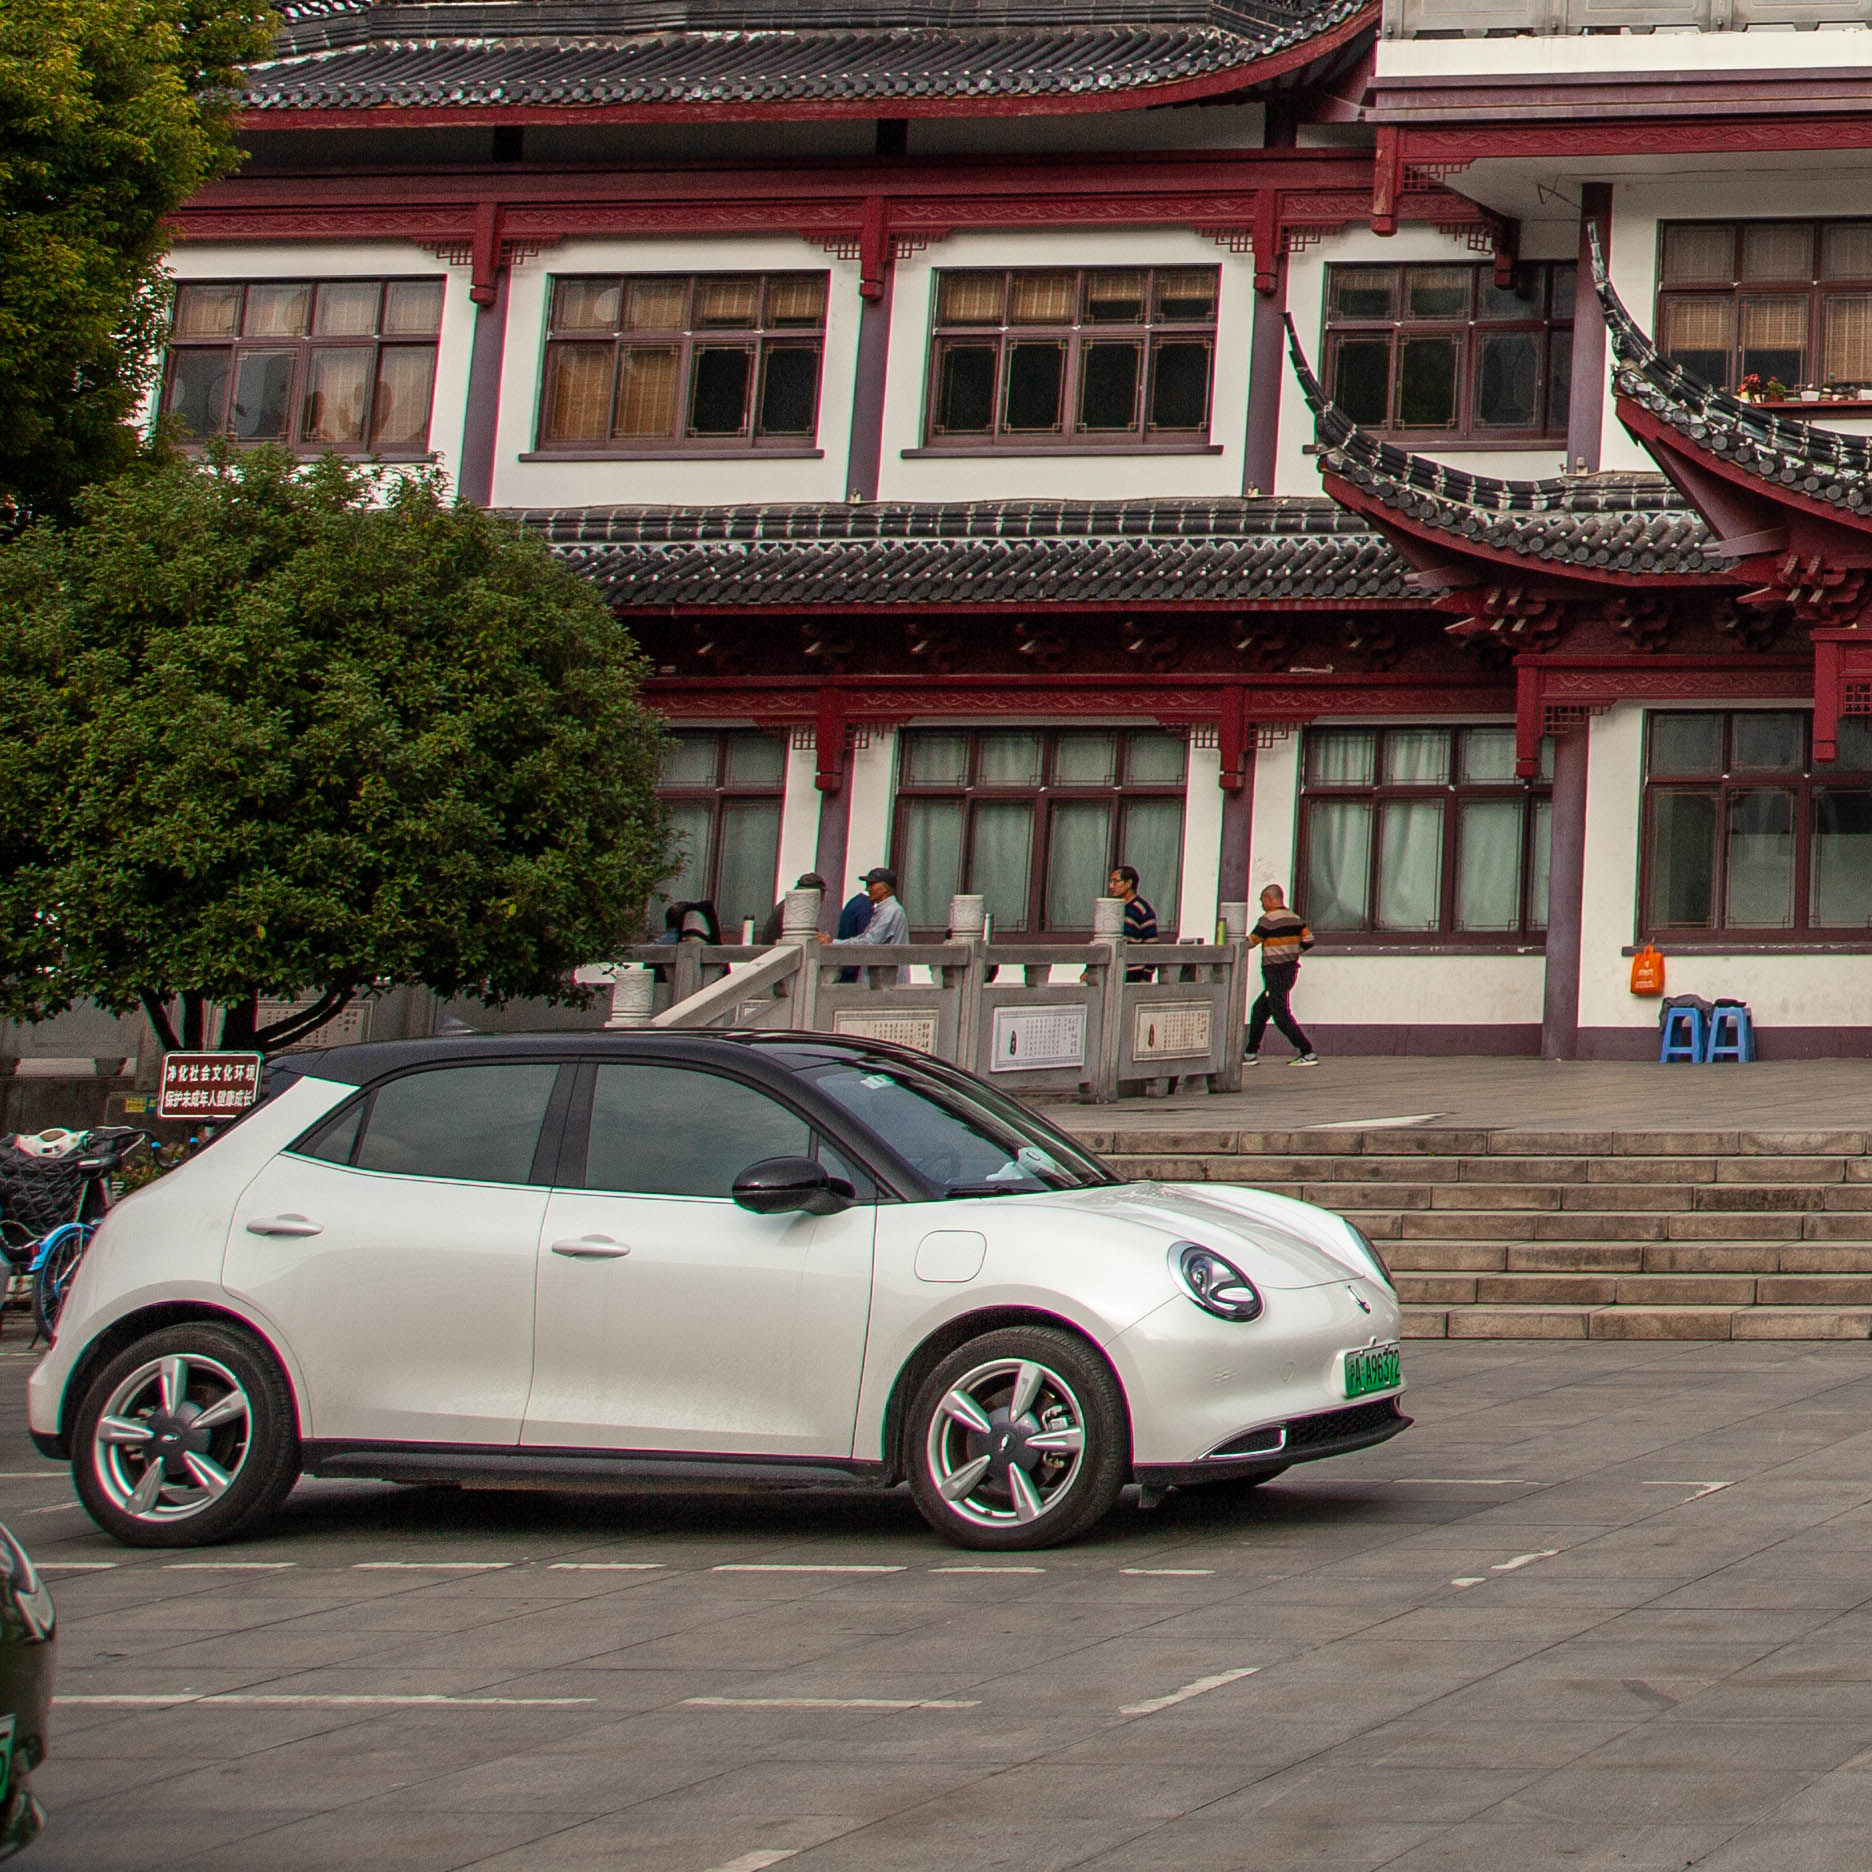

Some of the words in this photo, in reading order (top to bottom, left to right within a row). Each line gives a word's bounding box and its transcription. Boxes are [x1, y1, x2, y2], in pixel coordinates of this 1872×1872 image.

[167, 1064, 257, 1082] 净化社会文化环境
[164, 1089, 254, 1108] 保护未成年人健康成长
